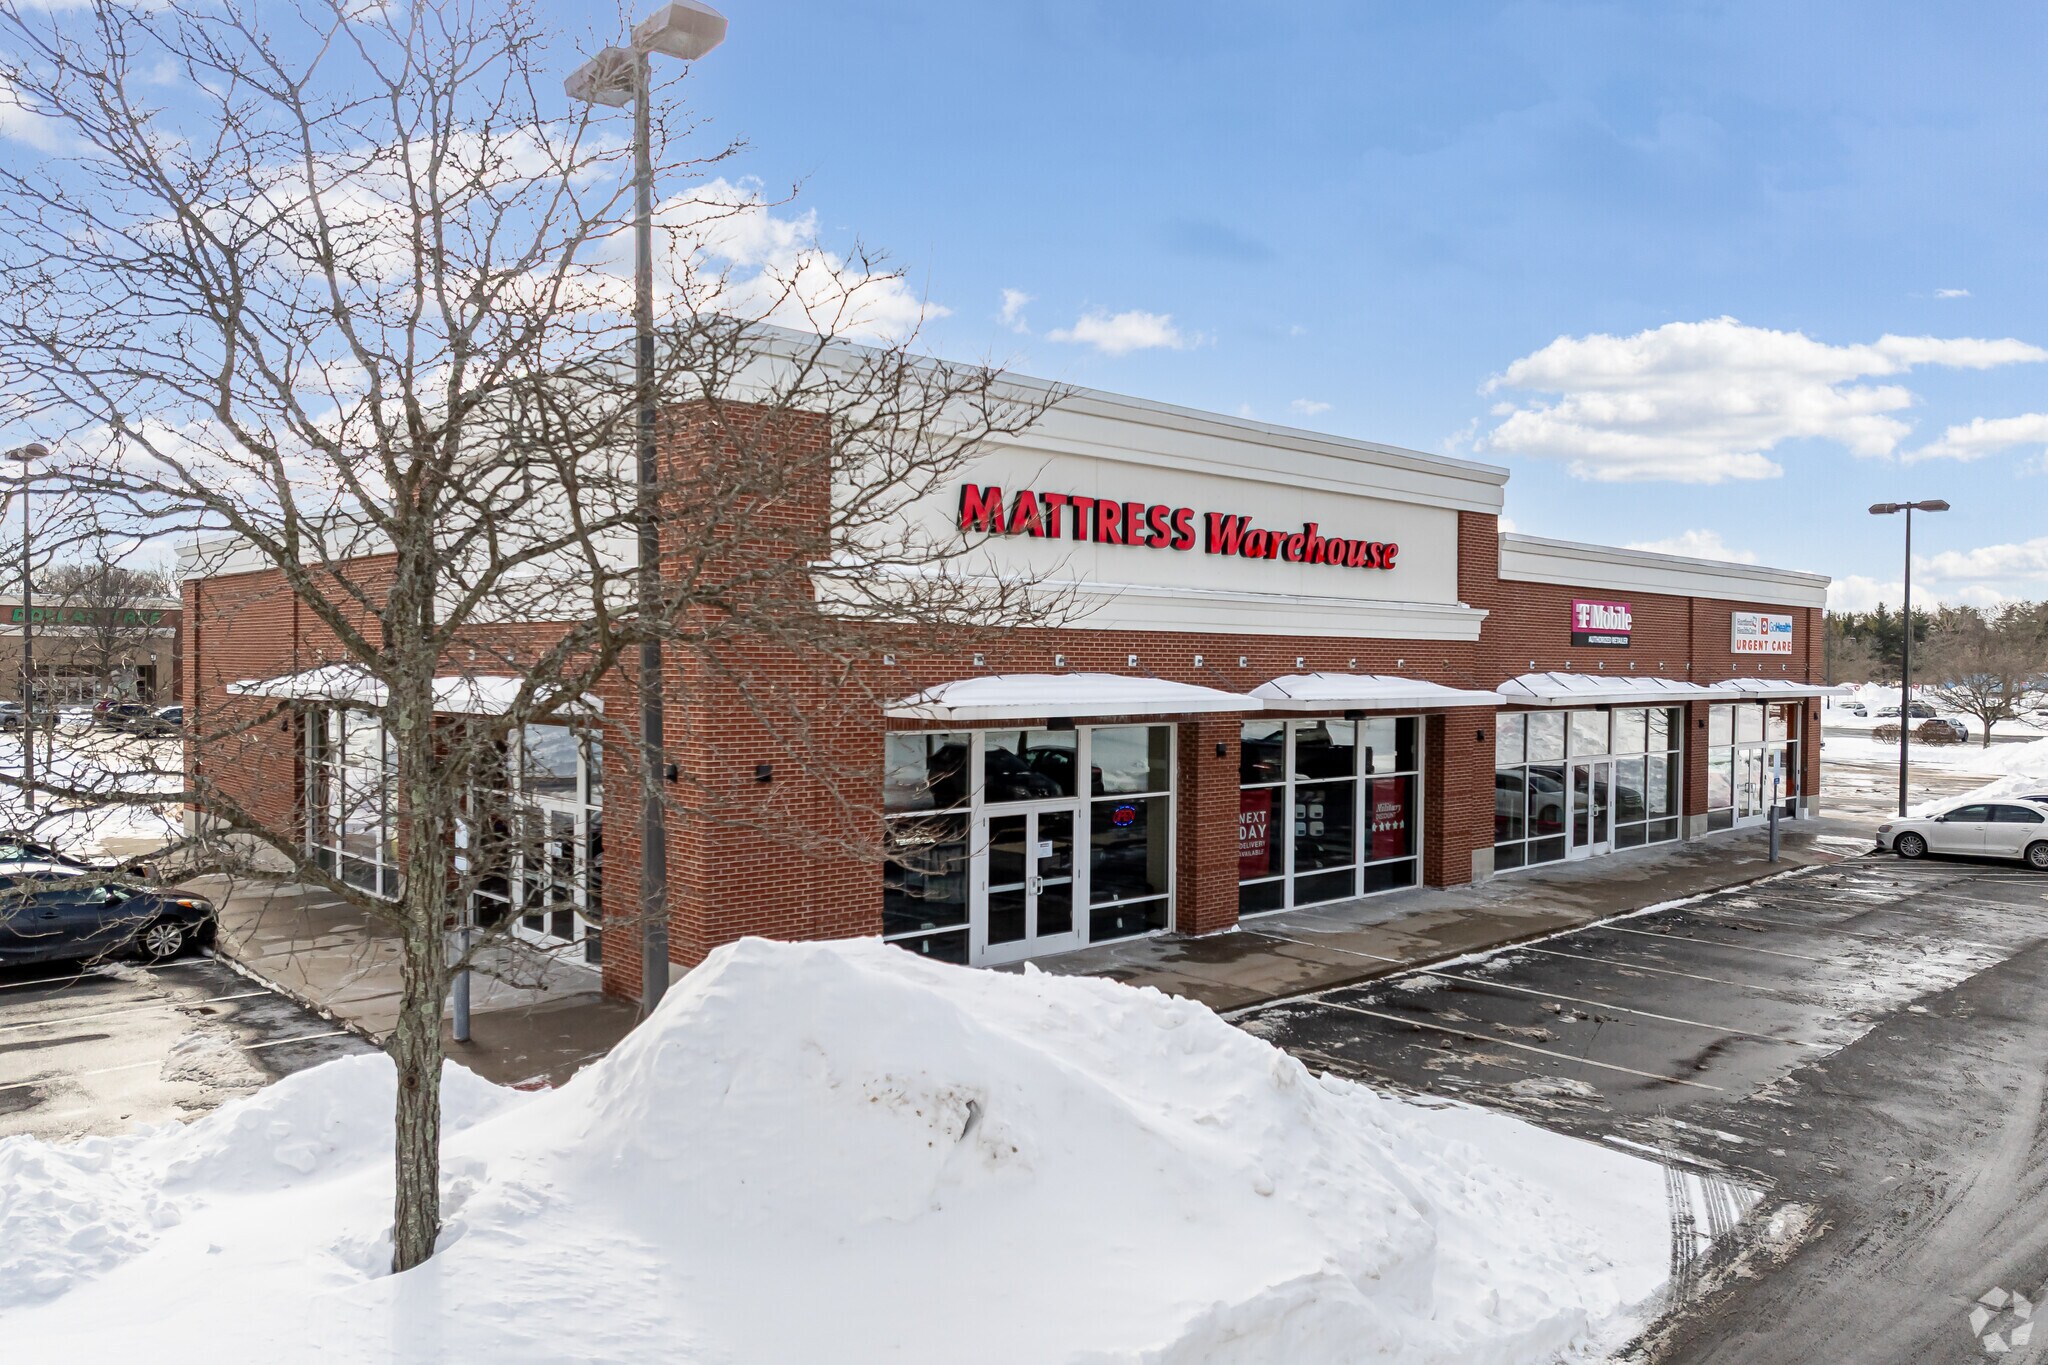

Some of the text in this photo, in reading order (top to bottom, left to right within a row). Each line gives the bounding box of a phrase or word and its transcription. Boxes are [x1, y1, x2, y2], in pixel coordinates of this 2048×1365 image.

[957, 483, 1399, 570] MATTRESS Warehouse
[1737, 639, 1791, 651] URGENT CARE
[1113, 809, 1134, 822] OPEN
[1239, 811, 1266, 824] NEXT
[1239, 823, 1266, 840] DAY
